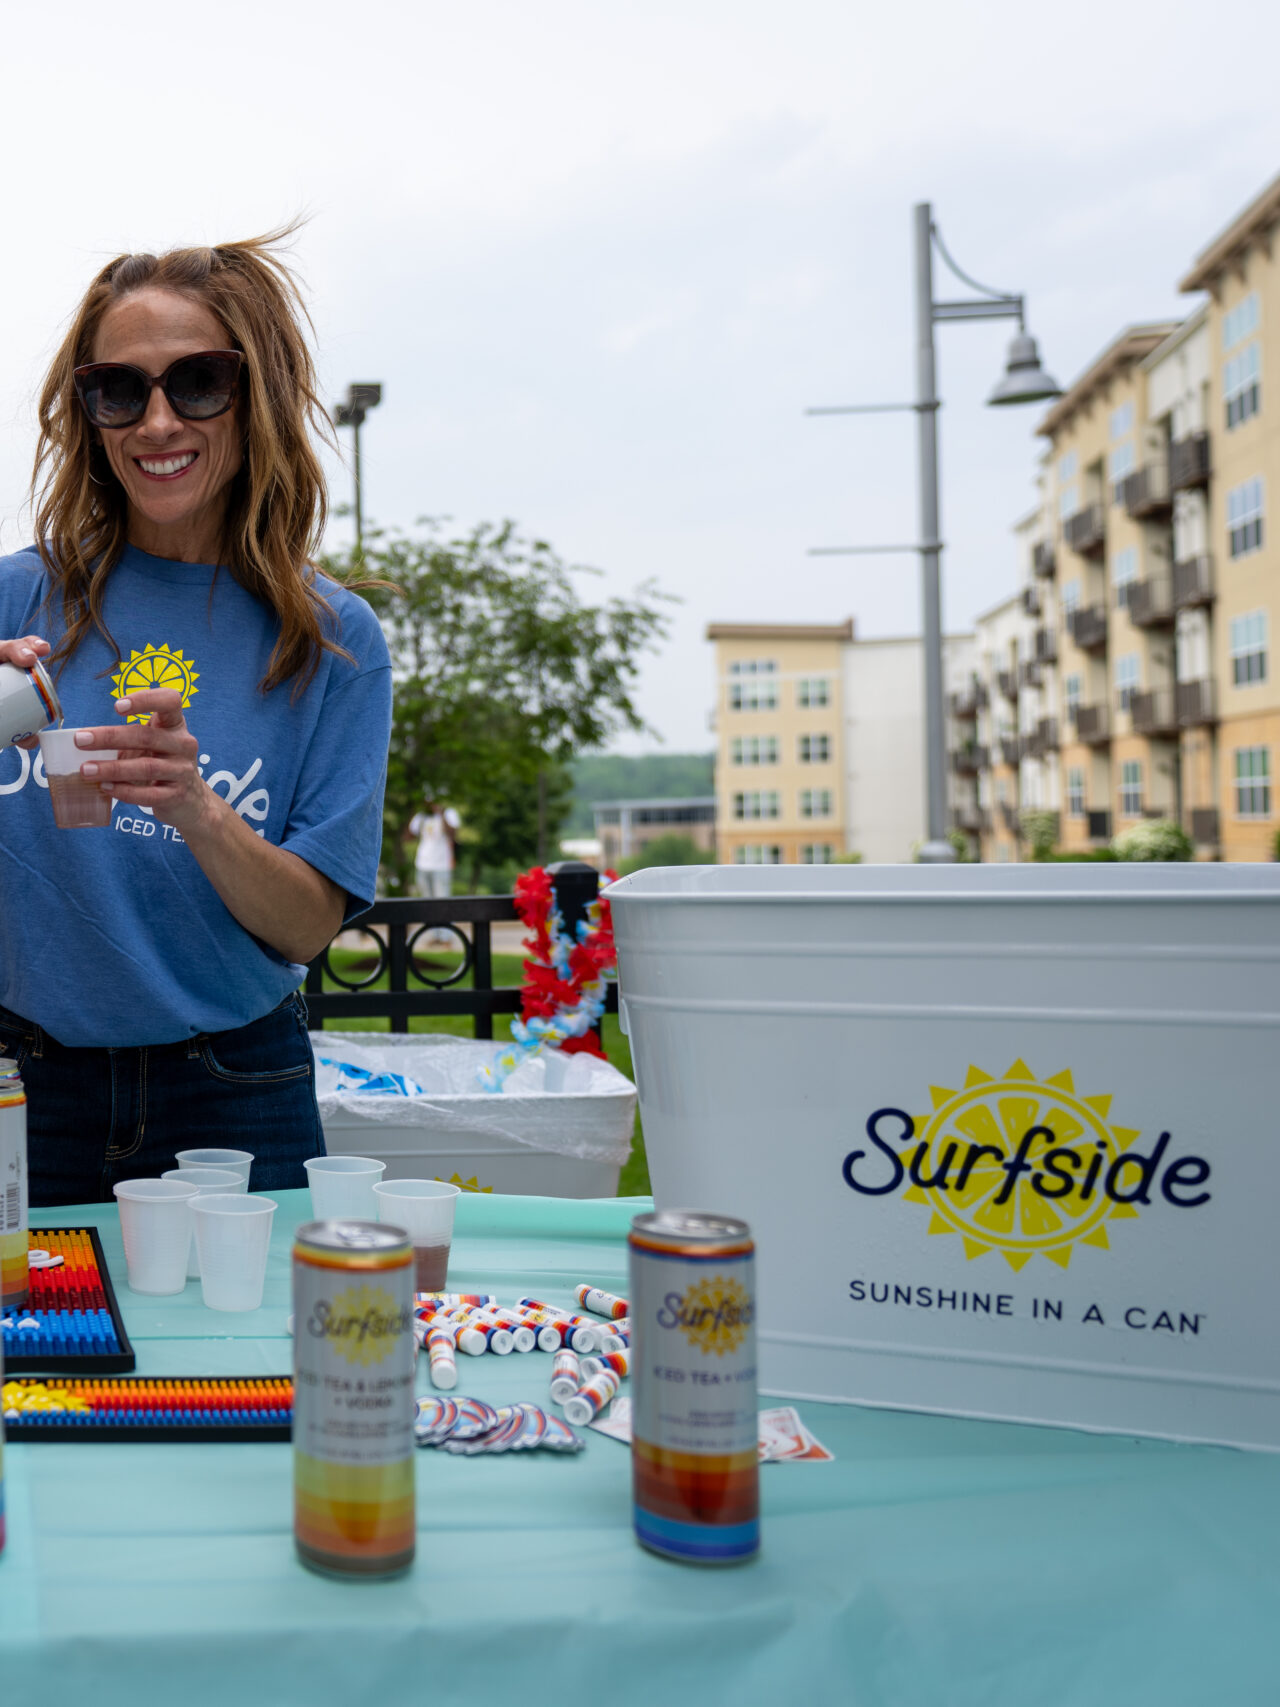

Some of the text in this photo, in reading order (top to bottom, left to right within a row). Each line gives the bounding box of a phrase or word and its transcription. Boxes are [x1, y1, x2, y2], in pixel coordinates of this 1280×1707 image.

[114, 815, 186, 844] ICED TE
[842, 1107, 1212, 1208] Surfside
[849, 1280, 1015, 1317] SUNSHINE
[1033, 1297, 1063, 1321] IN
[1082, 1303, 1105, 1326] A
[690, 1369, 721, 1386] TEA
